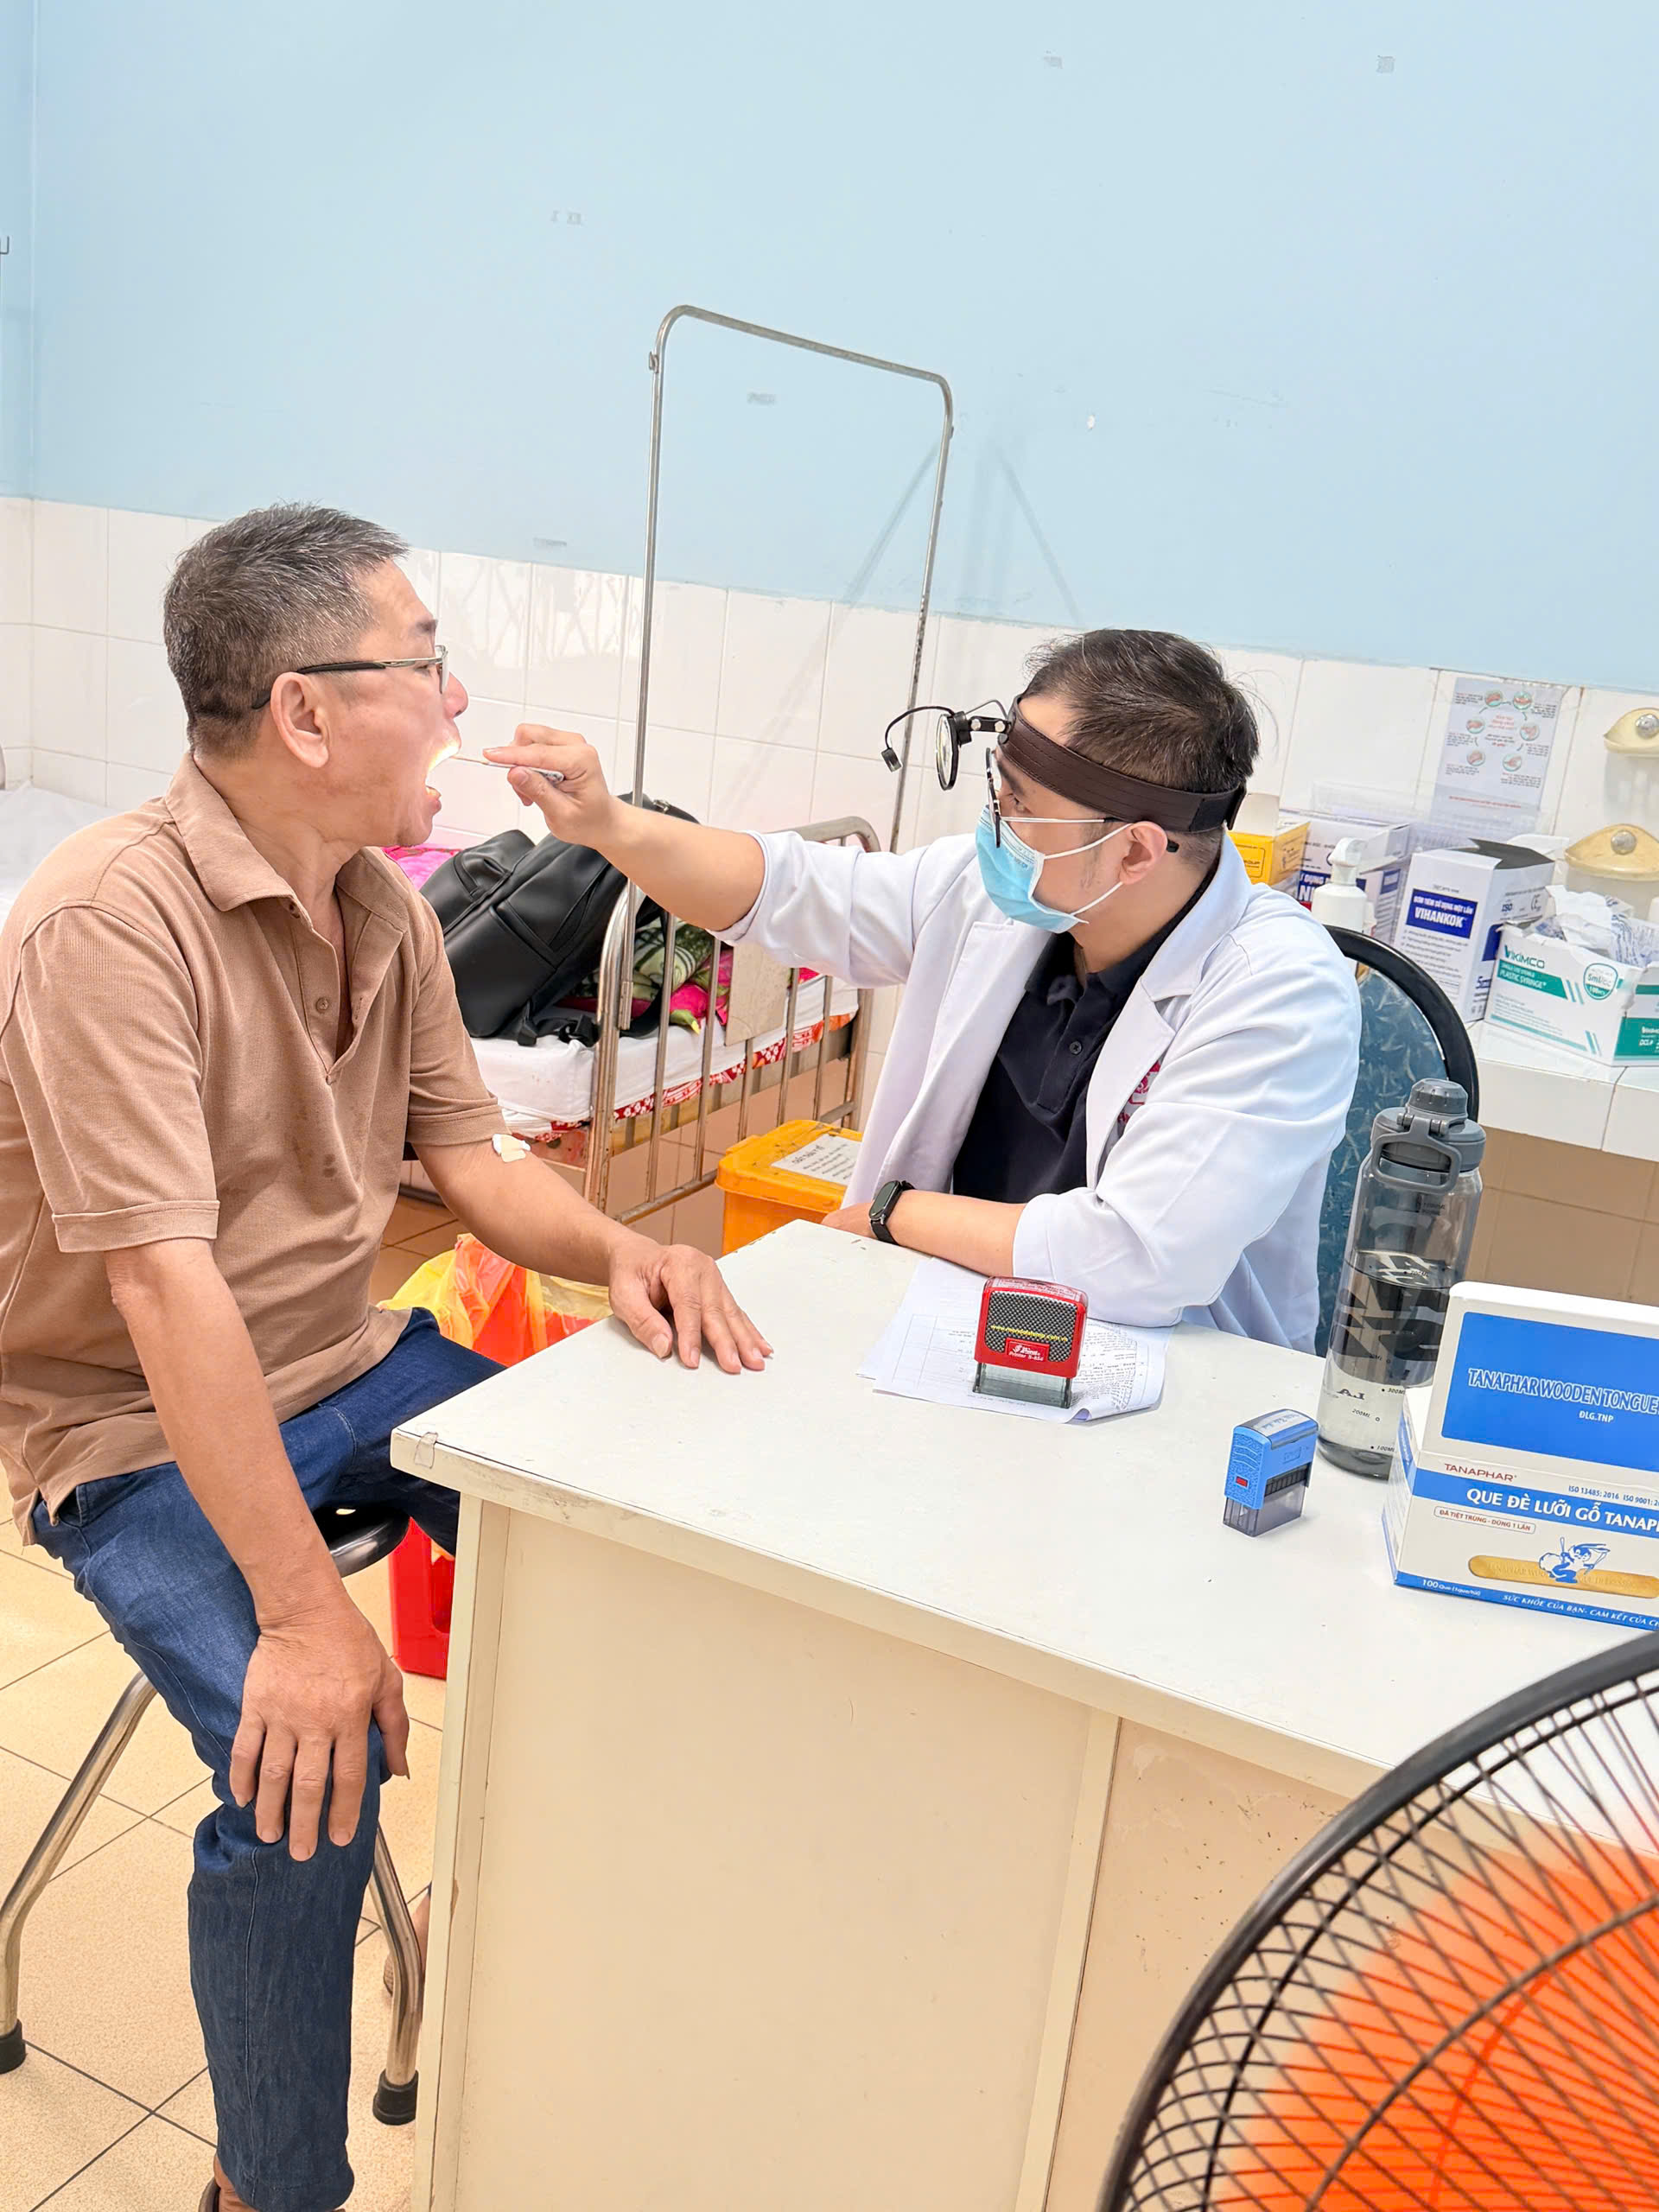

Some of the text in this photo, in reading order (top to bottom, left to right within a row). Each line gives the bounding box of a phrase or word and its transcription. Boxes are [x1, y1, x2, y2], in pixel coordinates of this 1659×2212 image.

[1414, 906, 1465, 928] VIHANKOK
[1504, 944, 1545, 969] VIKIMCO
[1468, 1368, 1658, 1415] TANAPHAR WOODEN TONGUE
[1444, 1463, 1514, 1483] TANAPHAR
[1568, 1485, 1580, 1494] ISO
[1580, 1487, 1603, 1498] 13485:
[1604, 1491, 1619, 1500] 2016
[1623, 1494, 1633, 1503] ISO
[1466, 1488, 1503, 1506] QUE
[1507, 1492, 1531, 1511] ĐÈ
[1534, 1499, 1572, 1518] LƯỠI
[1575, 1502, 1602, 1522] GỖ
[1422, 1579, 1439, 1588] 100
[1590, 1609, 1609, 1618] CAM
